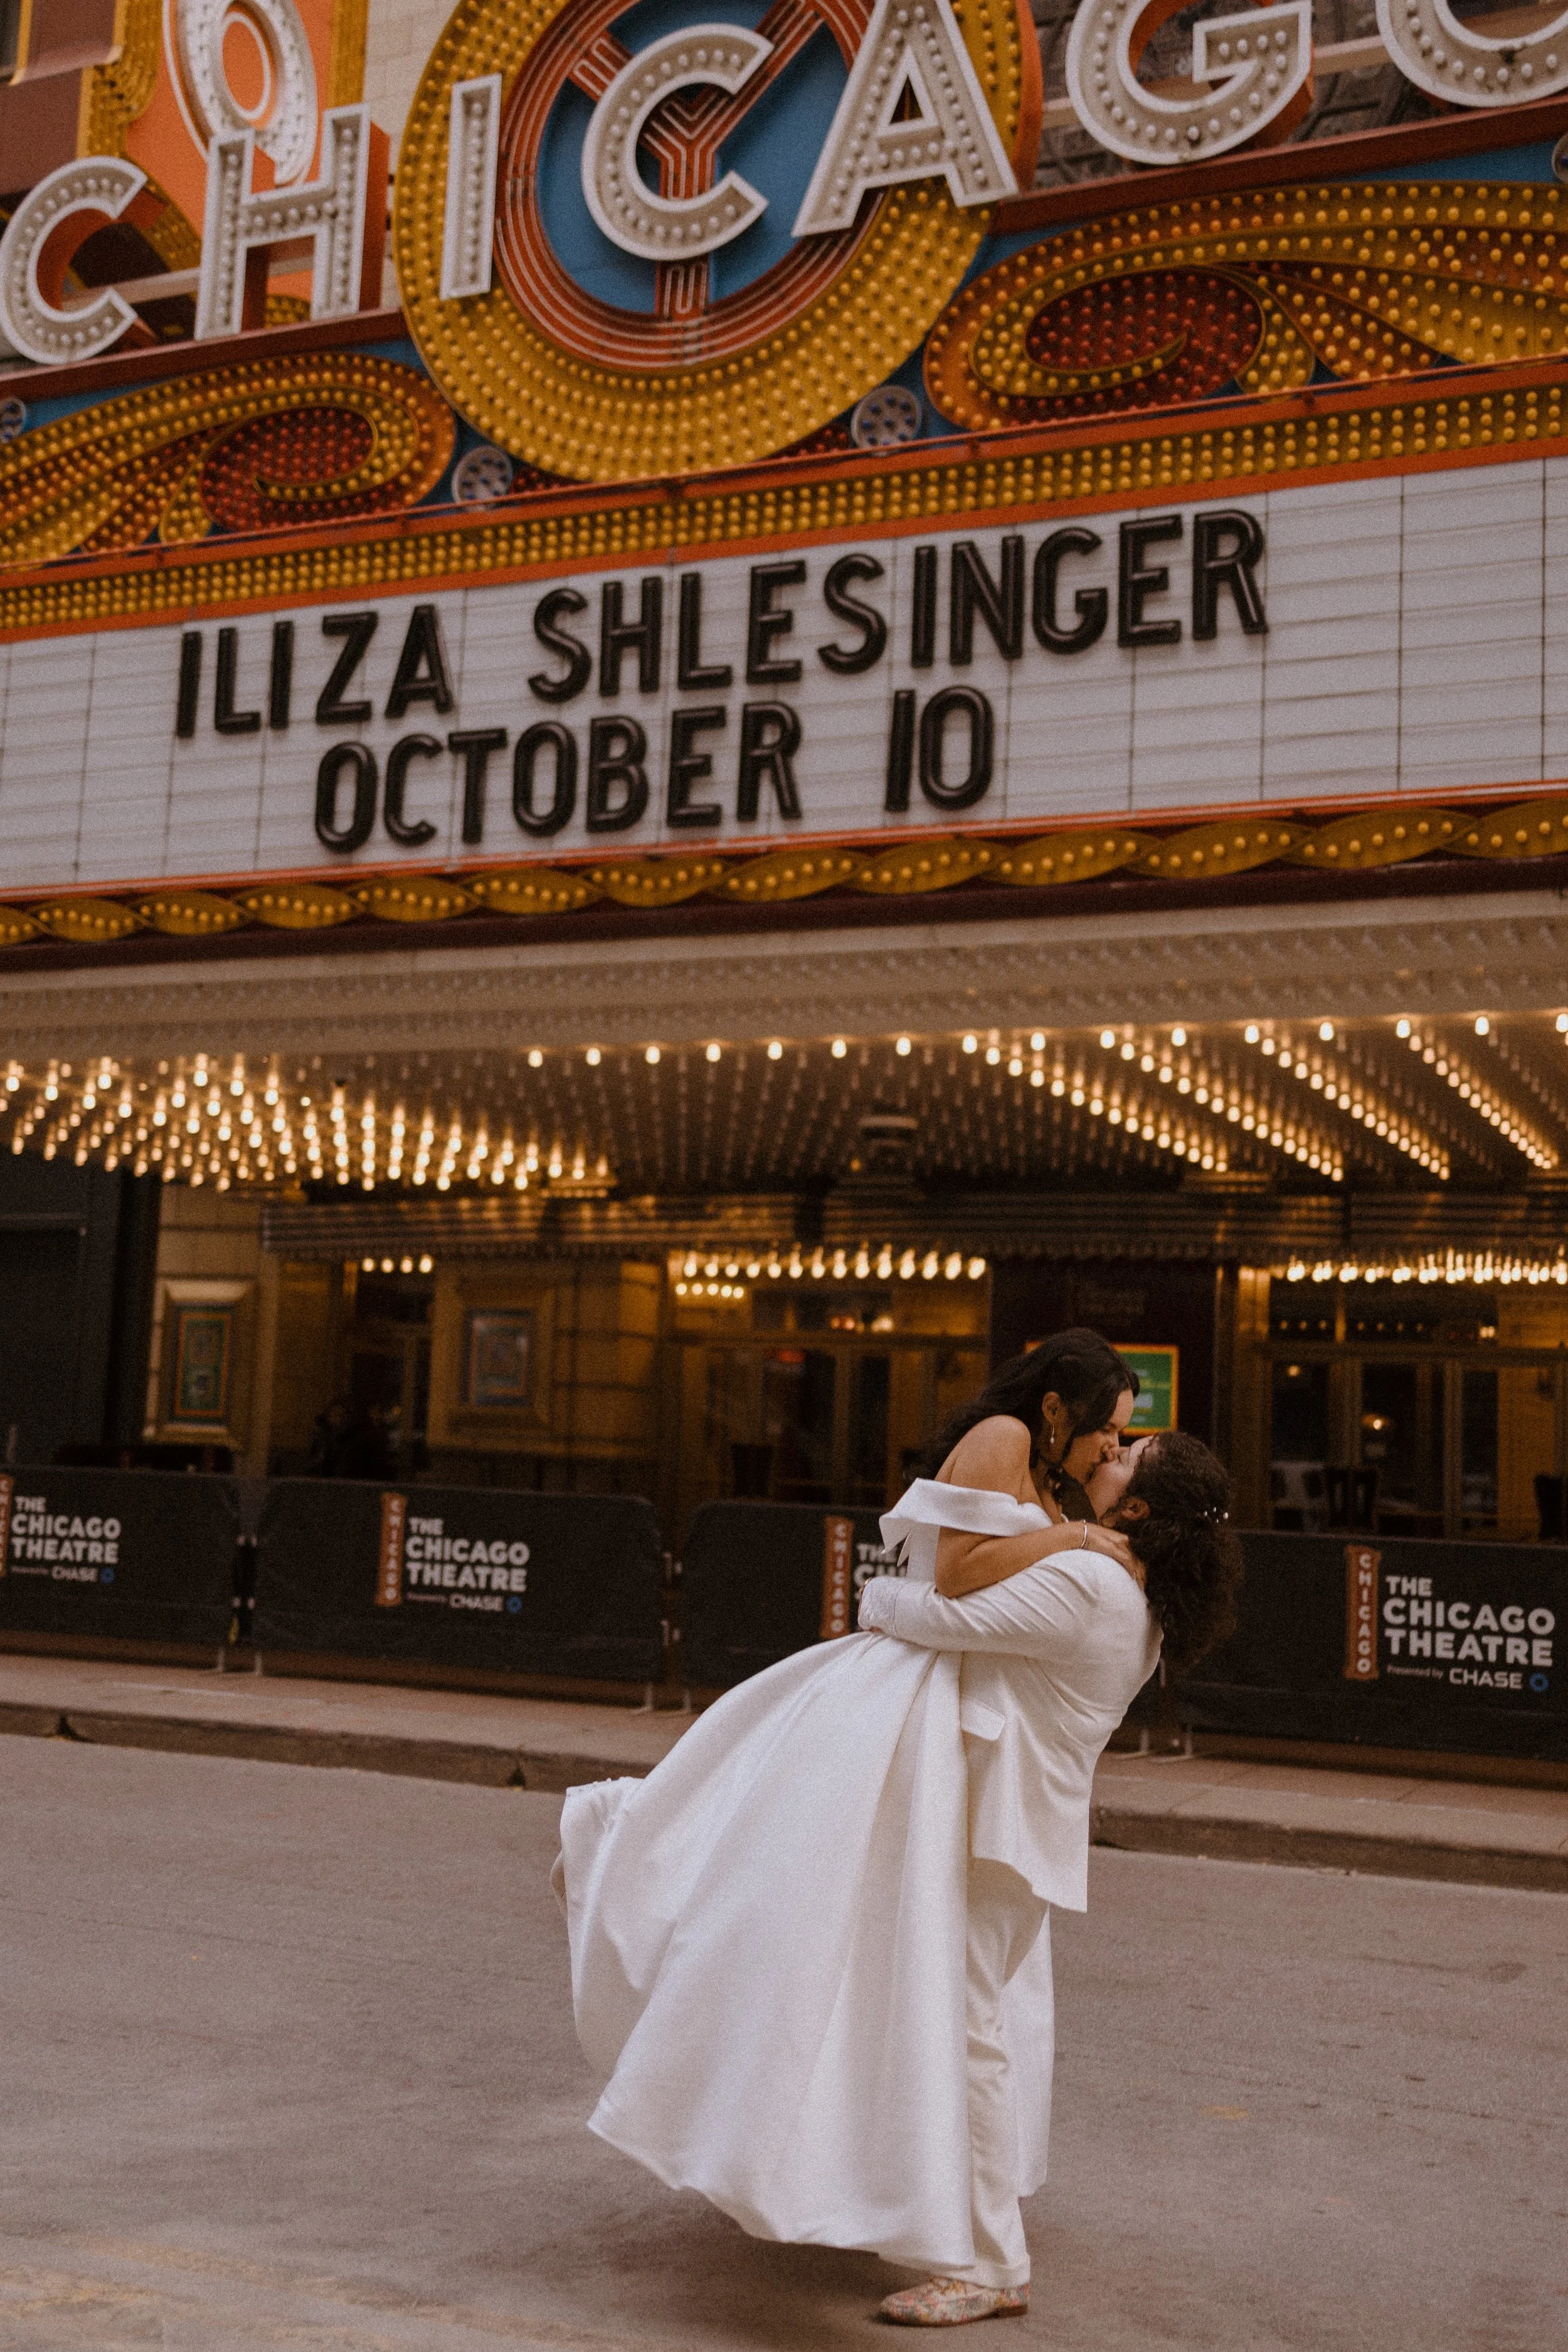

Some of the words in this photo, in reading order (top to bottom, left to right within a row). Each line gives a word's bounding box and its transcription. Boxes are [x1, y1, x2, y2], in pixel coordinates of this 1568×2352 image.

[177, 603, 453, 739] ILIZA
[528, 509, 1269, 703] SHLESINGER
[315, 700, 802, 854] OCTOBER
[884, 684, 994, 813] 10
[15, 1496, 46, 1513] THE
[11, 1513, 122, 1540] CHICAGO
[408, 1517, 444, 1535] THE
[11, 1537, 119, 1564] THEATRE
[385, 1500, 401, 1600] CHICAGO
[406, 1537, 530, 1566] CHICAGO
[406, 1561, 527, 1592] THEATRE
[831, 1524, 847, 1632] CHICAGO
[1385, 1576, 1433, 1597] THE
[1356, 1553, 1372, 1673] CHICAGO
[1382, 1598, 1555, 1635] CHICAGO
[1385, 1628, 1553, 1666] THEATRE
[1449, 1668, 1523, 1690] CHASE
